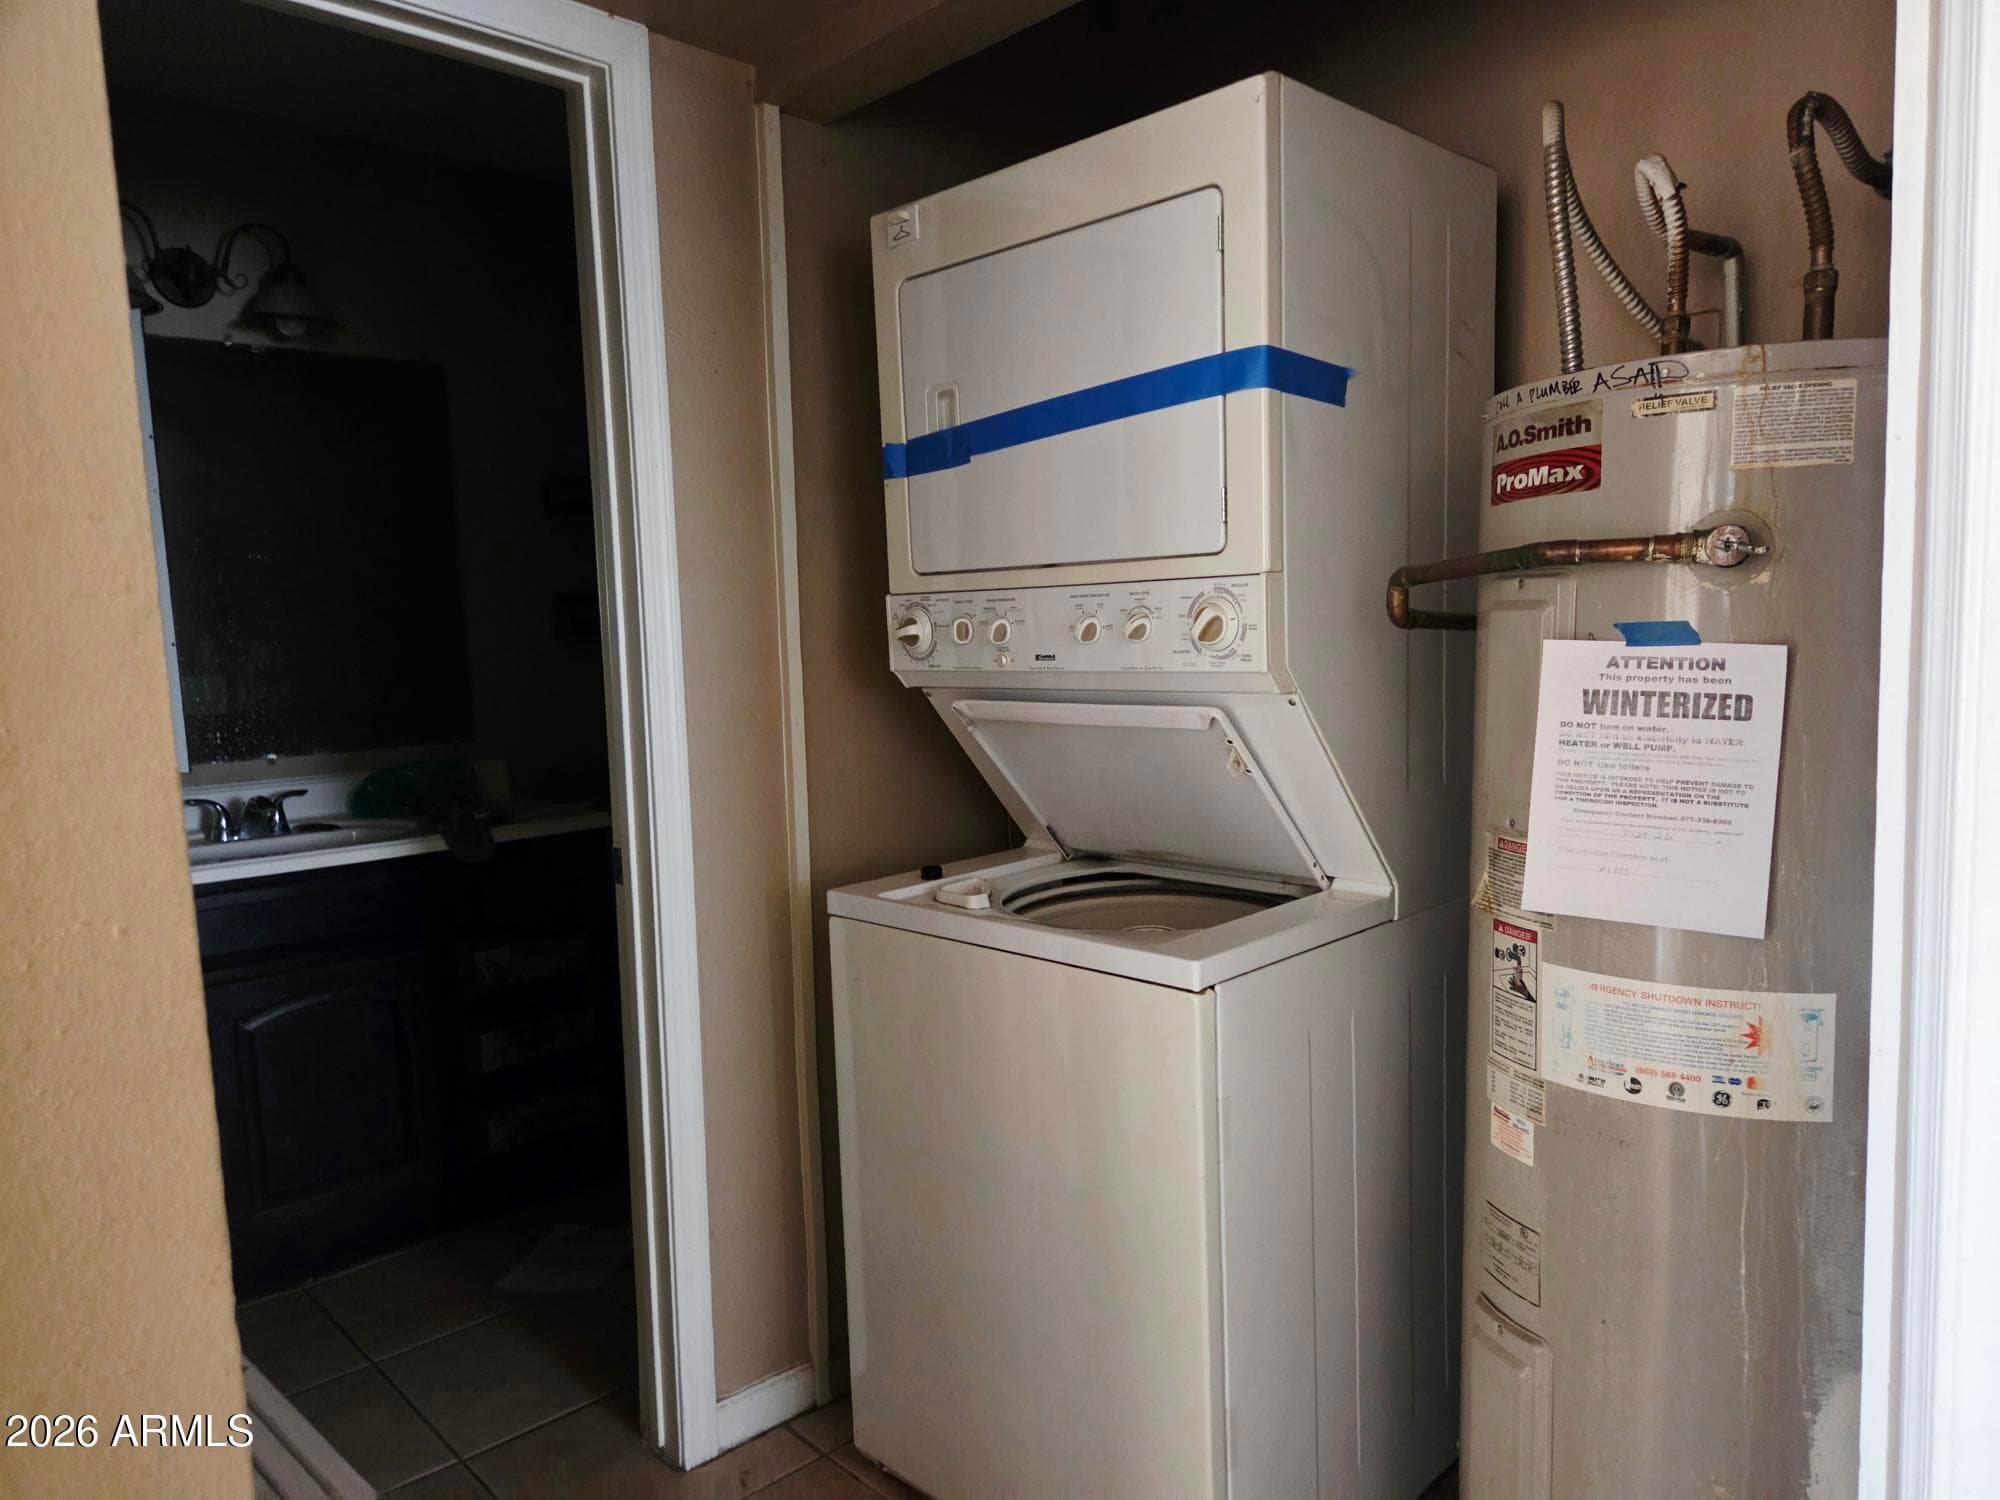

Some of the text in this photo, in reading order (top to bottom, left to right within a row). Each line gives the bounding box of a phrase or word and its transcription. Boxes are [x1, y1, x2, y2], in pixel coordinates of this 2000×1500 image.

[1516, 392, 1524, 406] A
[1675, 395, 1708, 409] VALVE
[1496, 465, 1584, 494] ProMax
[1606, 655, 1726, 671] ATTENTION
[1599, 673, 1732, 685] This property has been
[1582, 688, 1754, 721] WINTERIZED
[1576, 721, 1597, 729] NOT
[1599, 723, 1620, 731] turn
[1637, 725, 1670, 733] water.
[1558, 739, 1598, 748] HEATER
[1613, 742, 1641, 750] WELL
[1643, 744, 1677, 753] PUMP.
[1557, 758, 1571, 766] DO
[1573, 760, 1594, 768] NOT
[1711, 781, 1744, 789] DAMAGE
[1629, 789, 1692, 799] REPRESENTATION
[1576, 797, 1614, 805] THOROUGH
[1703, 800, 1750, 809] SUBSTITUTE
[1503, 841, 1527, 853] DANGE
[1504, 926, 1531, 941] DANGER
[1587, 983, 1638, 999] MERGENCY
[1640, 991, 1702, 1006] SHUTDOWN
[1636, 1066, 1658, 1078] (602)
